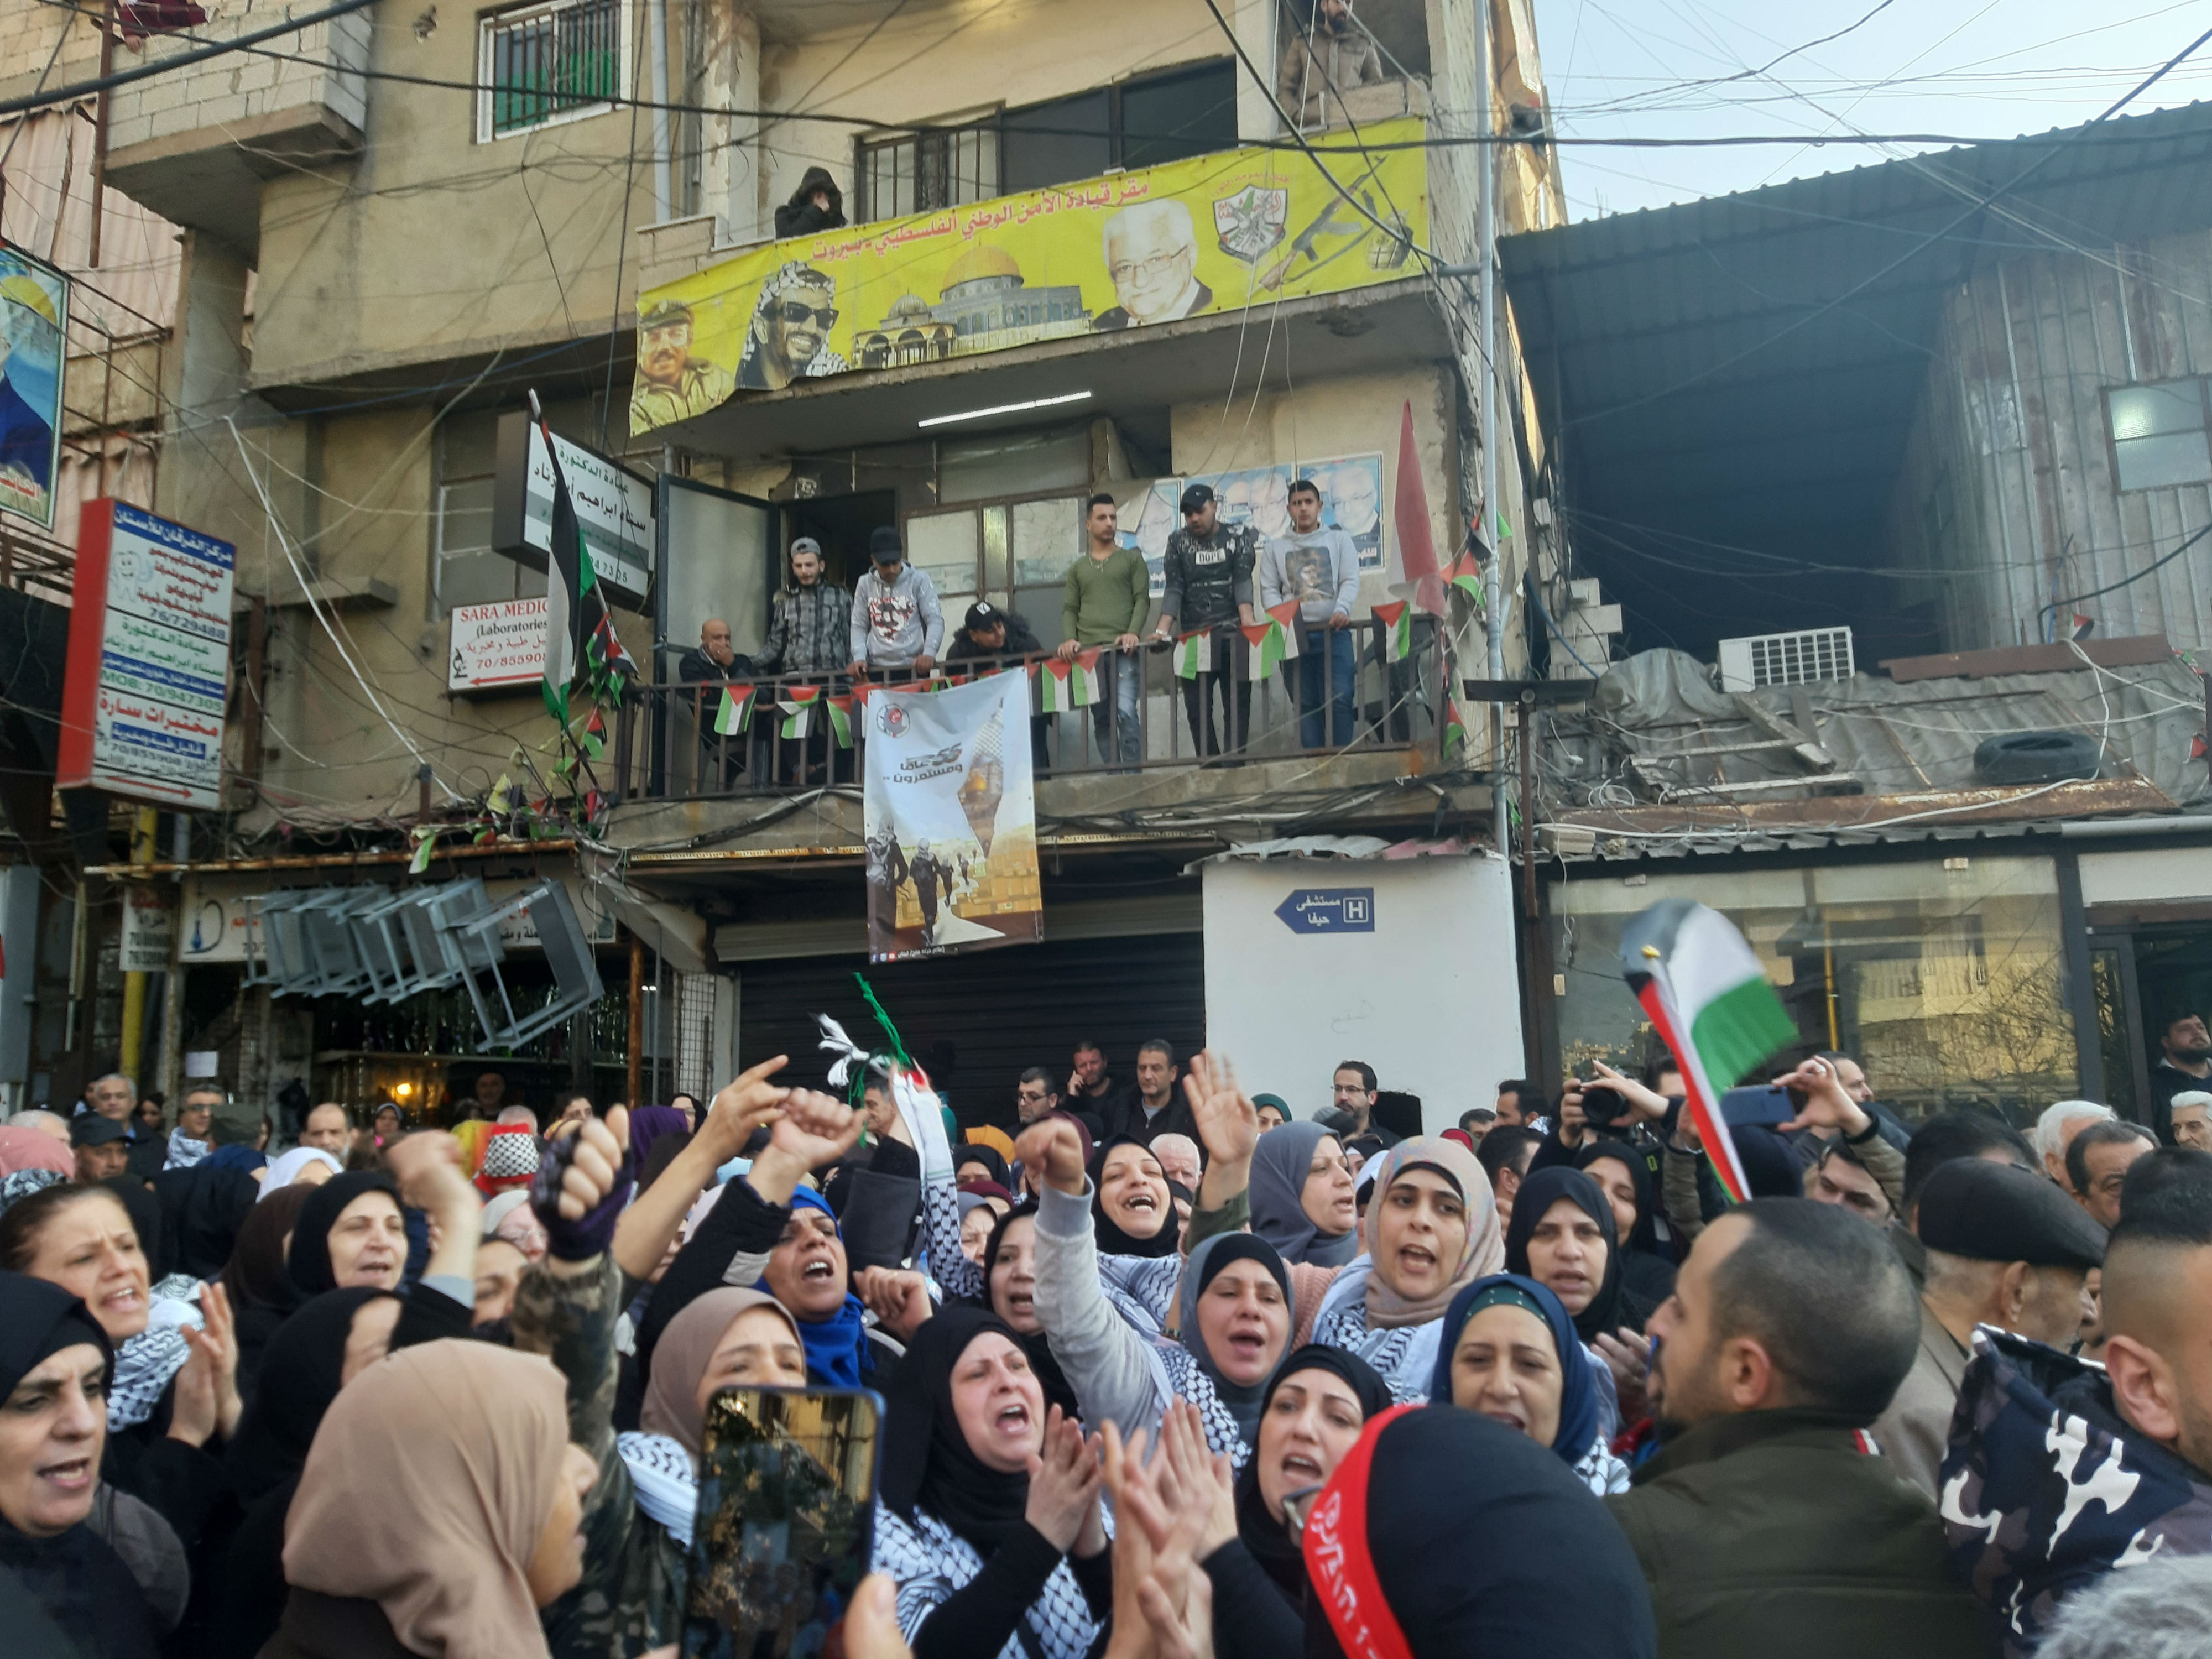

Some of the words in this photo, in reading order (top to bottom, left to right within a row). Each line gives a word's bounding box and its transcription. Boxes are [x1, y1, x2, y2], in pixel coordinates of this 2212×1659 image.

[1066, 182, 1111, 210] قيادة
[1117, 178, 1148, 206] مقر
[1017, 191, 1061, 225] الأمن
[962, 204, 1013, 240] الوطني
[812, 238, 862, 262] بيروت
[560, 445, 602, 477] الدكتورة
[604, 470, 628, 493] عيادة
[577, 491, 617, 519] ابراهيم
[114, 509, 163, 536] للأسنان
[620, 511, 646, 531] سناء
[163, 527, 205, 552] الفرقان
[204, 541, 232, 562] مركز
[150, 608, 225, 640] 76/729488
[461, 606, 499, 623] SARA
[123, 616, 174, 643] الدكتورة
[106, 636, 125, 651] زناد
[176, 634, 209, 656] عيادة
[467, 640, 494, 655] مخبرية
[507, 635, 528, 649] طبية
[194, 662, 223, 677] سناء
[99, 691, 142, 718] سارة
[145, 683, 222, 712] 70/947305
[145, 707, 218, 738] مختبرات
[894, 764, 962, 784] ومستمرون
[1296, 895, 1341, 912] مستشفى
[1348, 900, 1363, 919] H
[1307, 912, 1330, 927] حيفا
